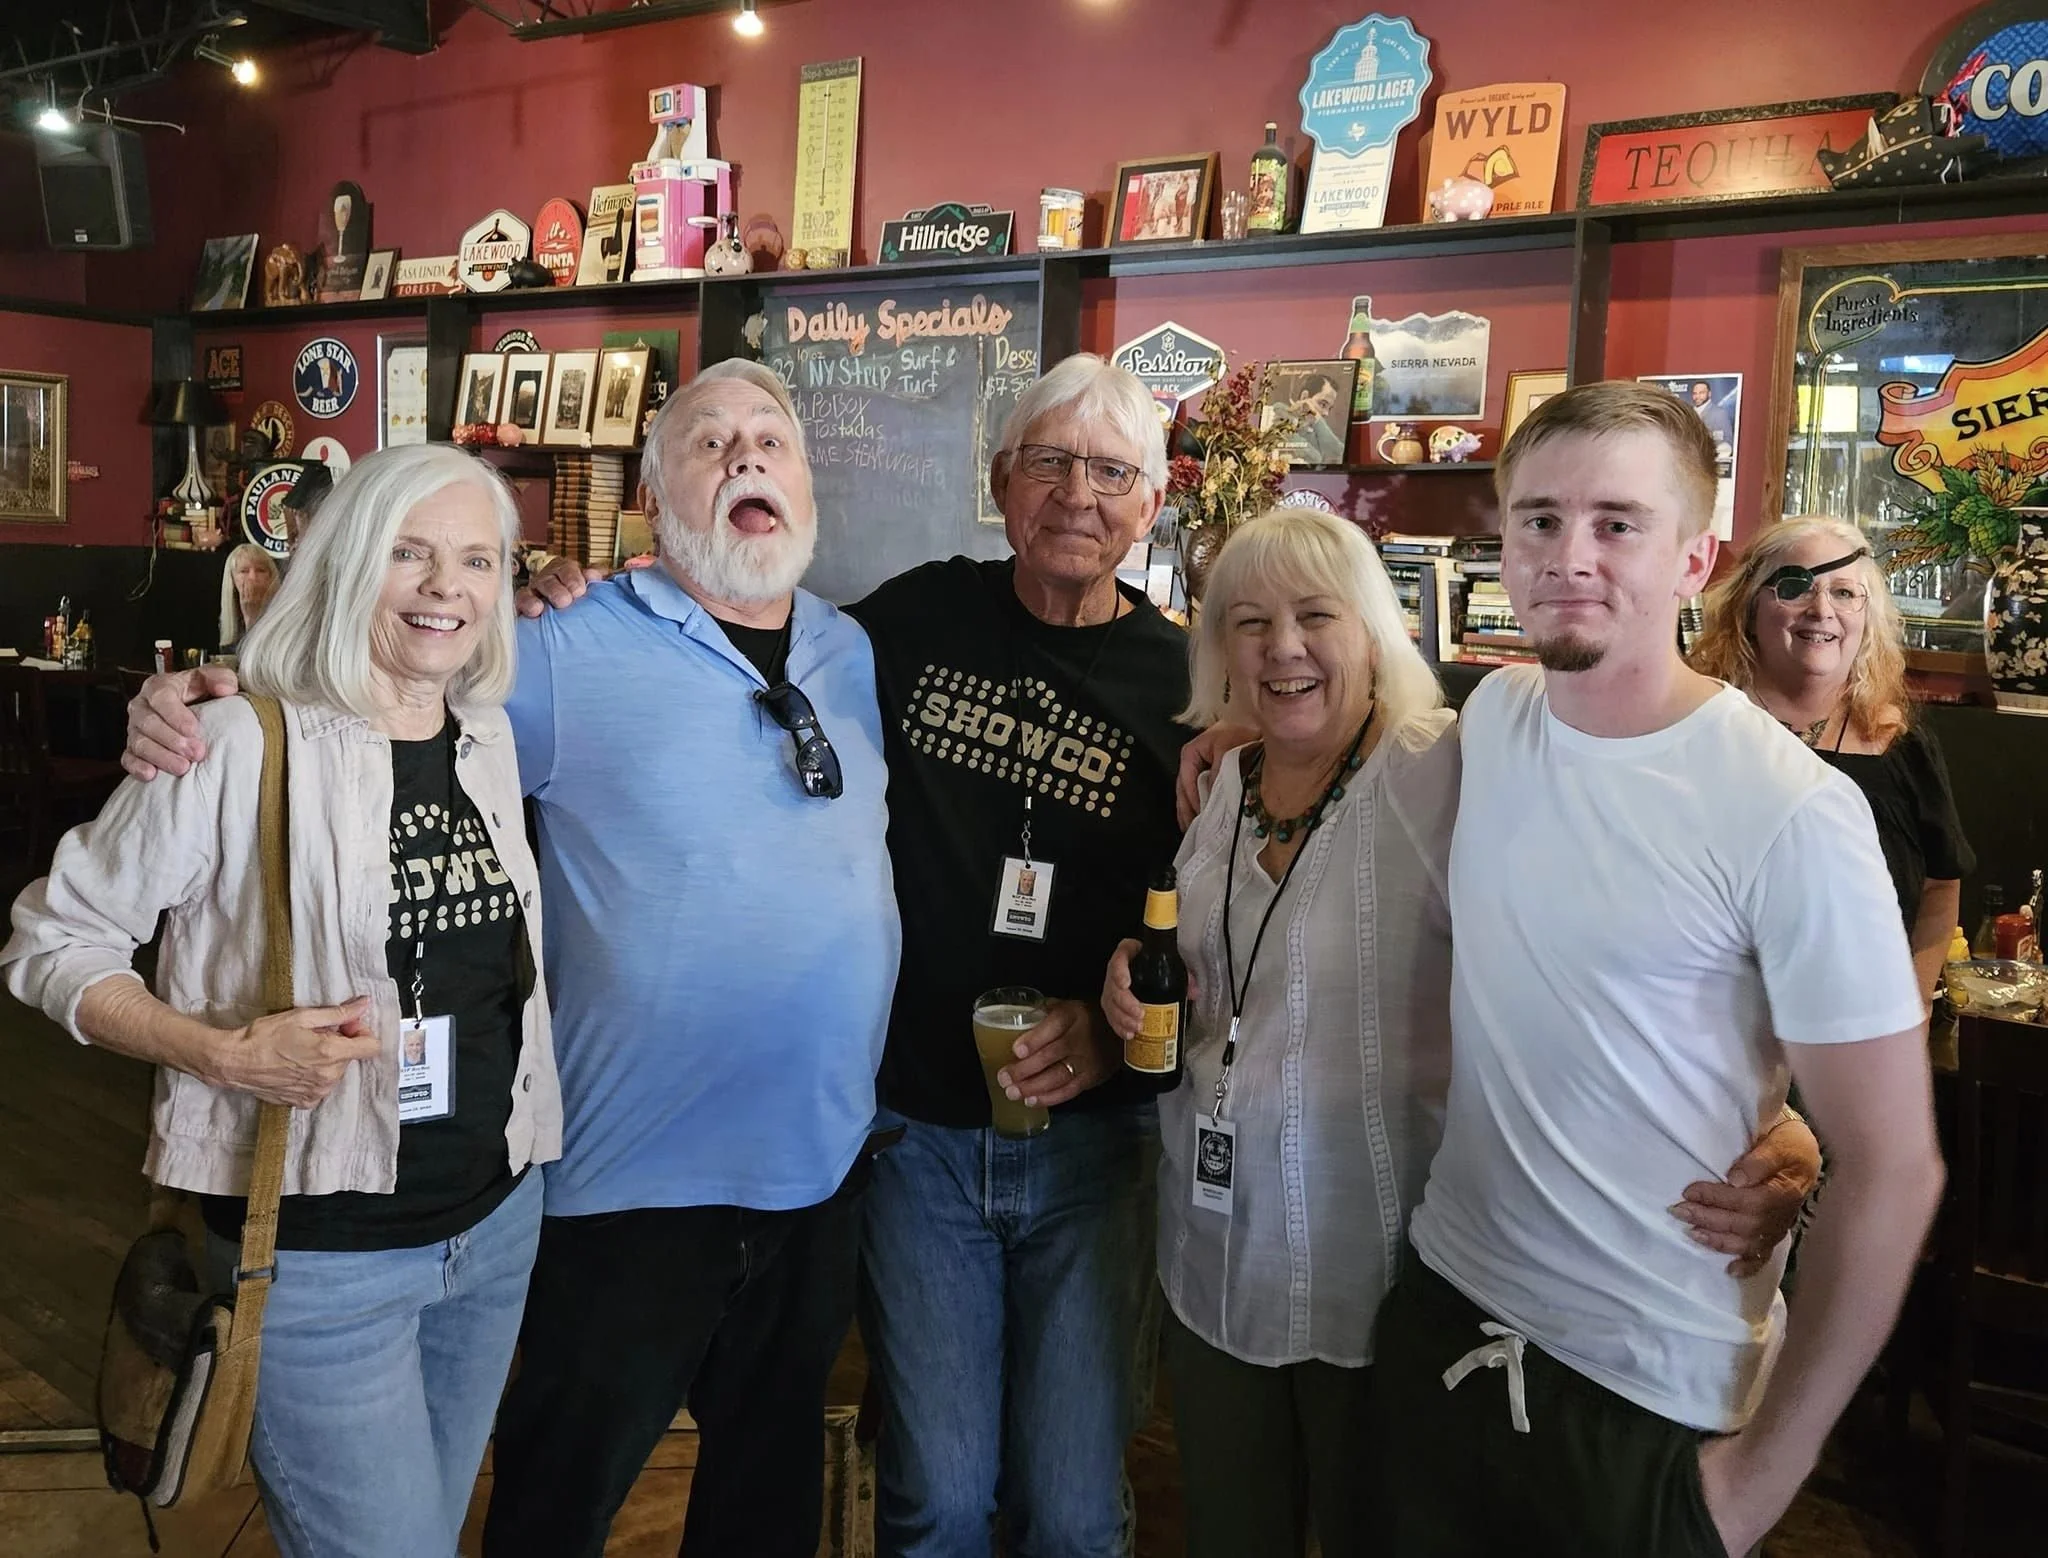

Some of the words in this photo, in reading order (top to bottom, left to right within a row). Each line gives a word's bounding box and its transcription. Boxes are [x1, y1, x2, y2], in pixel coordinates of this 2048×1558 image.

[1312, 84, 1375, 109] LAKEWOOD
[1377, 79, 1415, 100] LAGER
[1971, 59, 2048, 121] CO
[1445, 102, 1552, 141] WYLD
[593, 194, 633, 218] Liefmans
[1313, 185, 1379, 204] LAKEWOOD
[1496, 201, 1521, 212] PALE
[1524, 200, 1544, 210] ALE
[899, 222, 990, 253] Hillridge
[463, 243, 521, 262] LAKEWOOD
[540, 251, 575, 269] UINTA
[395, 267, 418, 282] CASA
[418, 264, 446, 280] LINDA
[399, 284, 438, 295] FOREST
[1836, 293, 1881, 312] Purest
[788, 302, 870, 355] Daily
[877, 294, 1012, 347] Specials
[1825, 306, 1919, 336] Ingredients
[208, 349, 240, 379] ACE
[297, 344, 324, 375] LONE
[326, 342, 352, 374] STAR
[900, 346, 940, 370] Surf
[1121, 346, 1212, 377] Session
[1391, 359, 1429, 369] SIERRA
[1432, 357, 1477, 368] NEVADA
[808, 359, 836, 388] NY
[838, 353, 891, 391] Strip
[898, 370, 939, 394] Turf
[1151, 384, 1180, 393] BLACK
[311, 397, 340, 413] BEER
[919, 691, 1112, 783] SHOWCO
